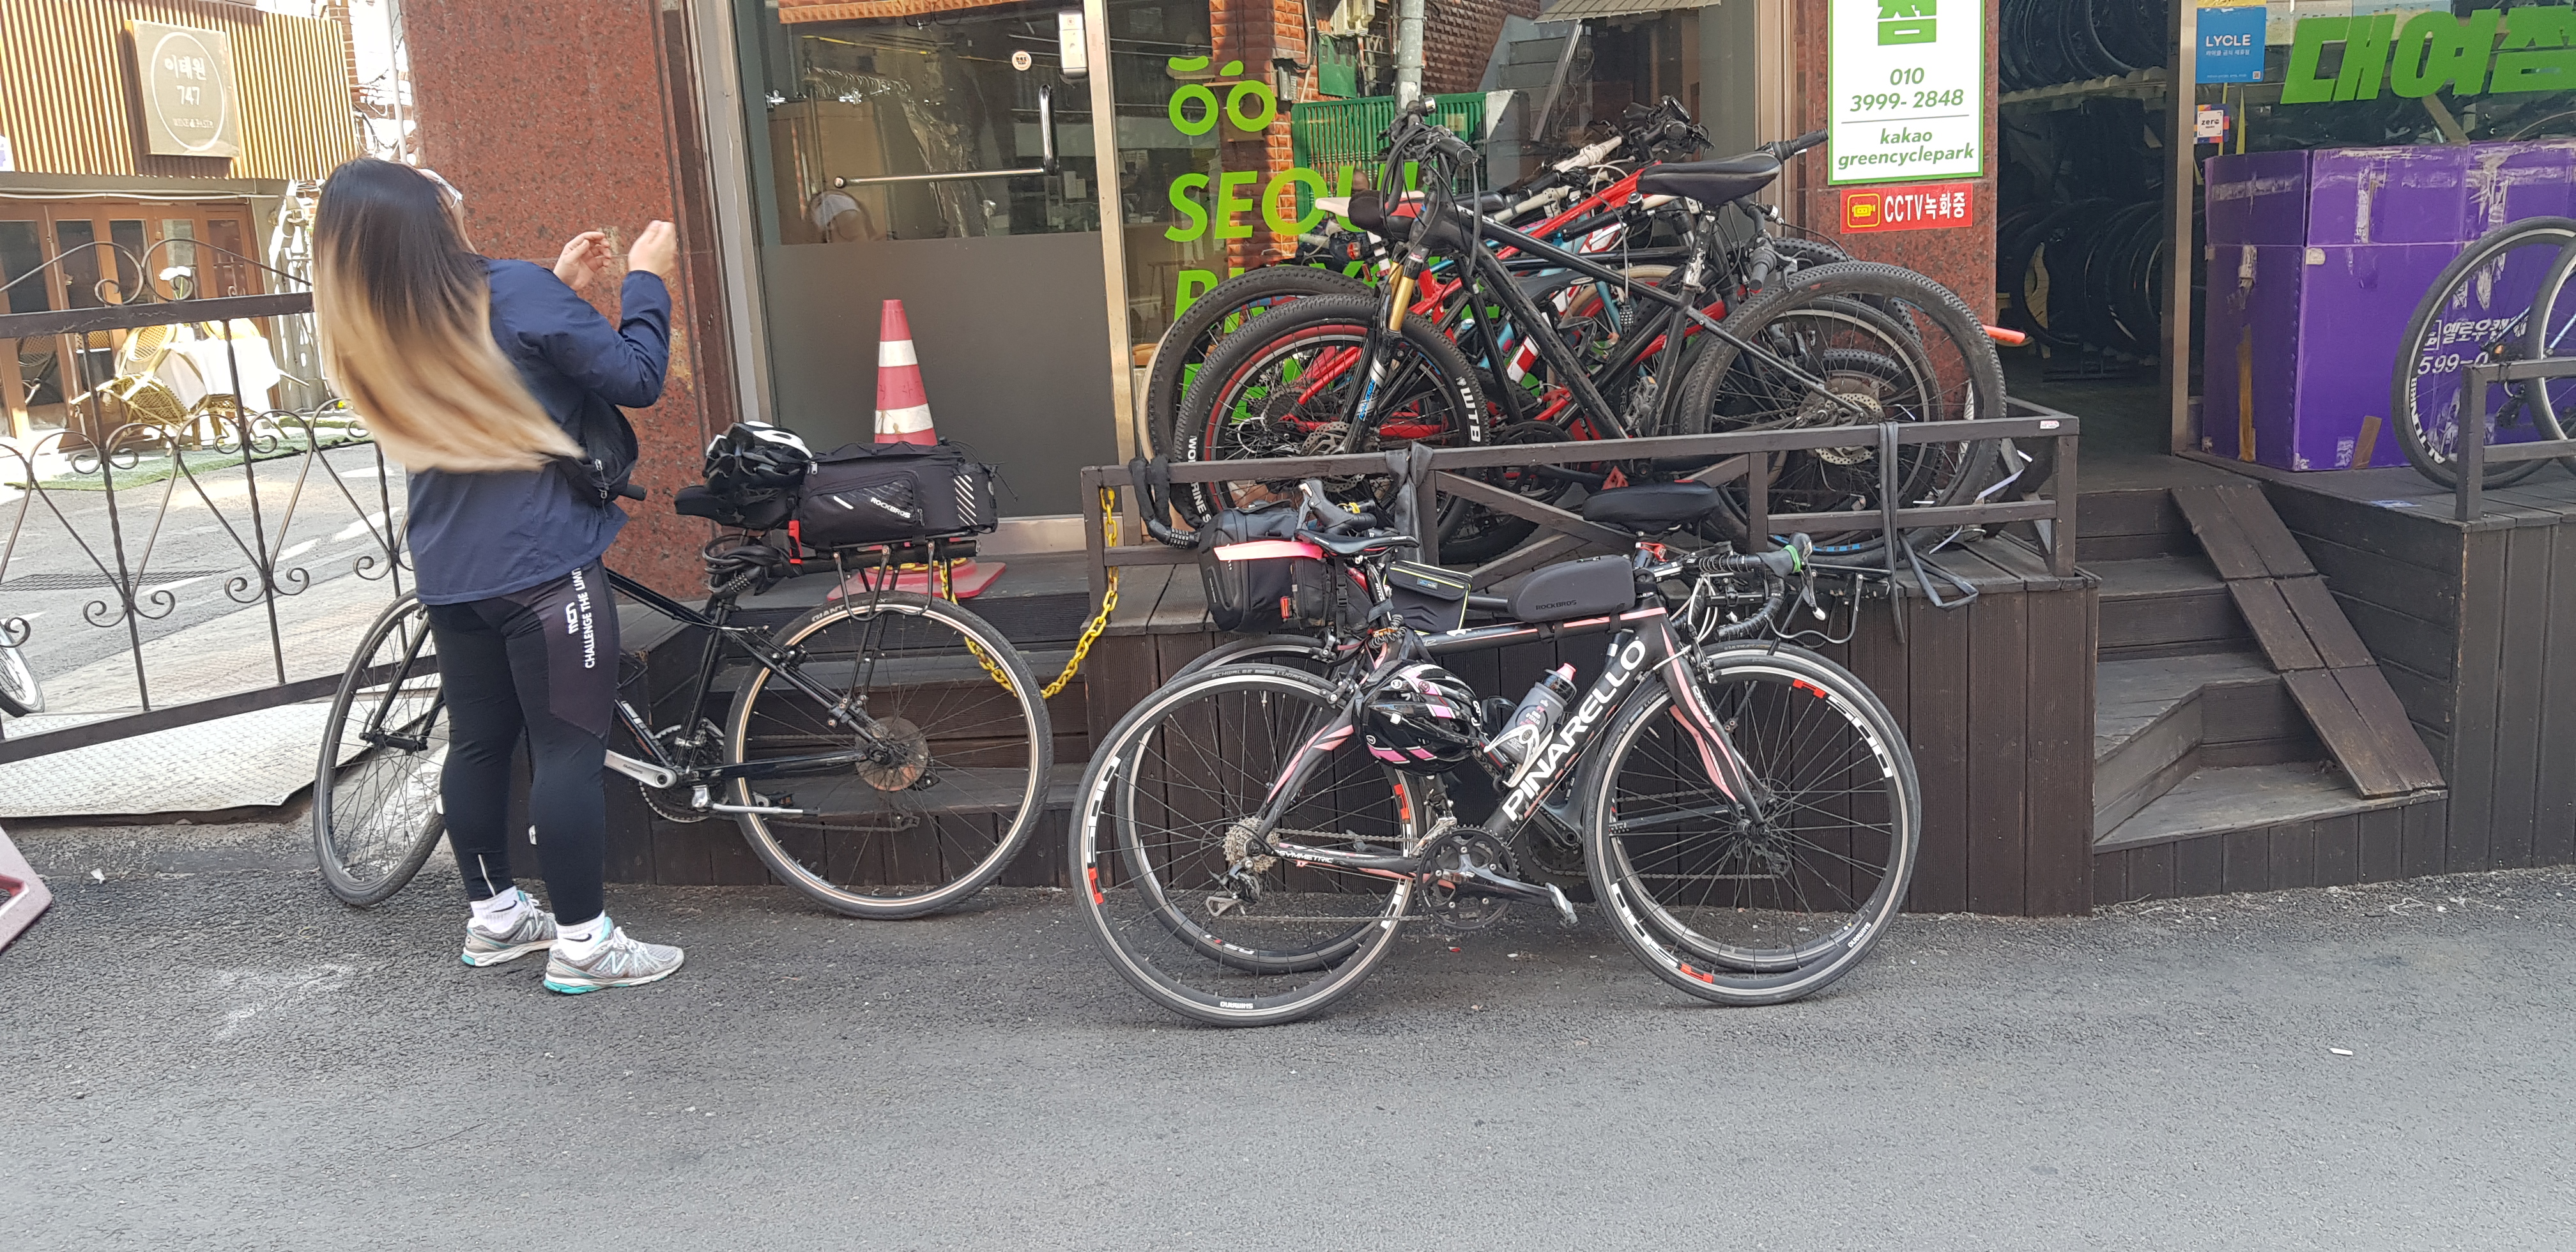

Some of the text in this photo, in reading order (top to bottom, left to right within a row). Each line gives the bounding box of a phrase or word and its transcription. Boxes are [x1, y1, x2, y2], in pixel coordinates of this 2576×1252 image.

[2205, 34, 2251, 47] LYCLE
[164, 54, 207, 80] 이태원
[1890, 67, 1924, 86] 010
[176, 85, 201, 106] 747
[1850, 89, 1964, 112] 3999- 2848
[1880, 127, 1933, 144] kakao
[1839, 142, 1975, 170] greencyclepark
[1884, 192, 1966, 223] CCTV녹화중
[1460, 387, 1481, 442] WTB
[870, 497, 911, 519] ROCKBROS
[578, 592, 591, 613] THE
[811, 604, 845, 622] GIANT
[1535, 600, 1577, 611] ROCKBROS
[582, 612, 595, 669] CHALLENGE
[1211, 669, 1308, 682] SCHWALBE LUGANO
[1502, 640, 1646, 821] PINARELLO
[1608, 723, 1629, 758] SCHWALBE
[1220, 1001, 1254, 1009] SHIMANO
